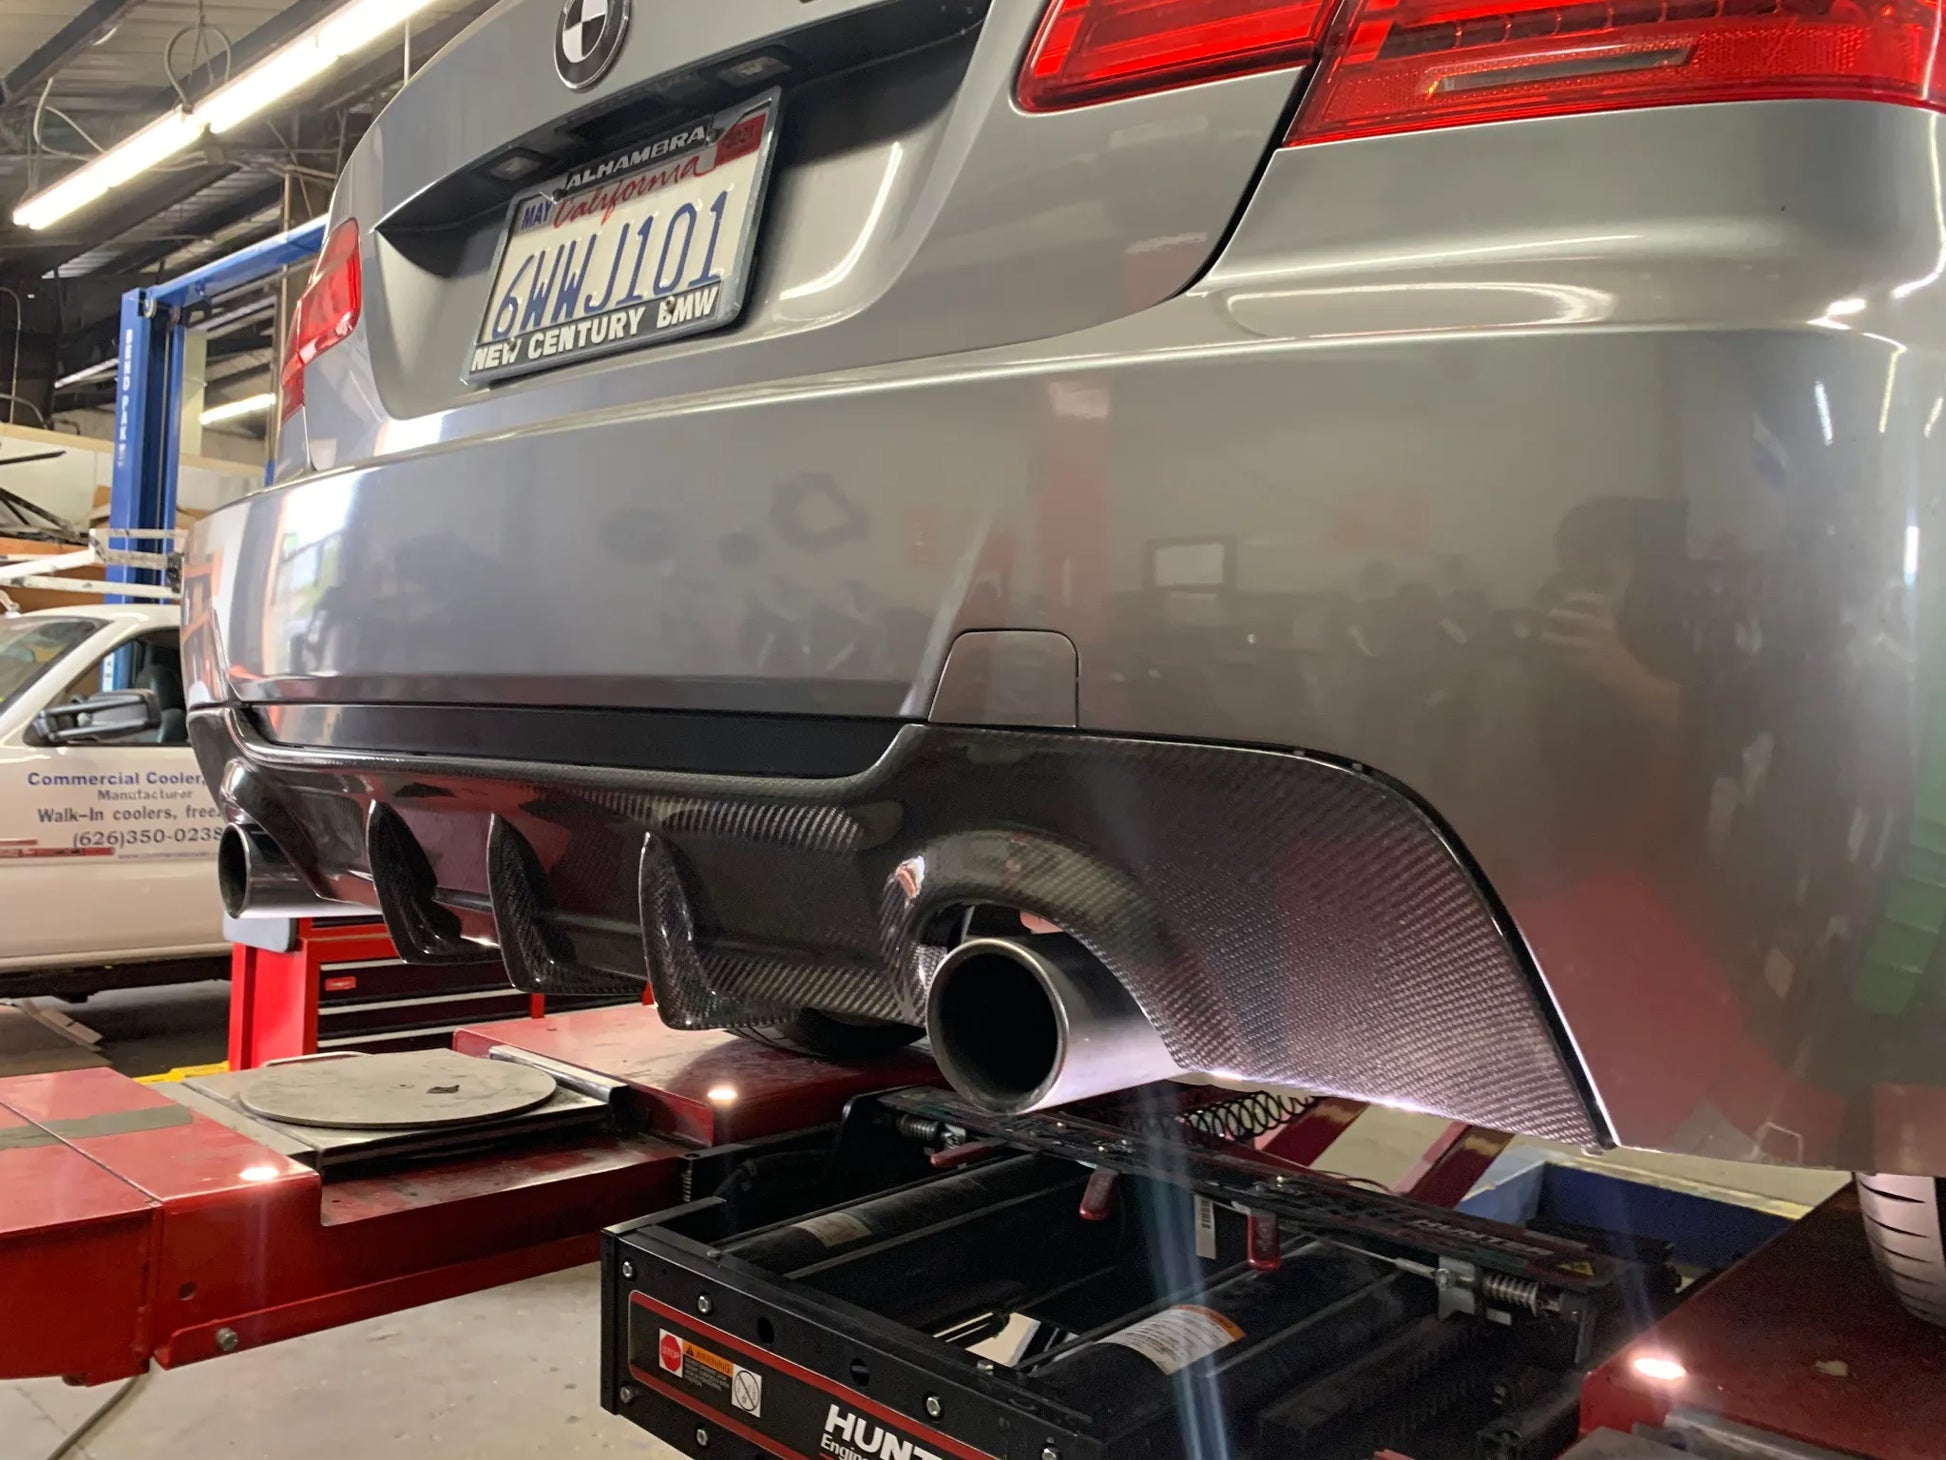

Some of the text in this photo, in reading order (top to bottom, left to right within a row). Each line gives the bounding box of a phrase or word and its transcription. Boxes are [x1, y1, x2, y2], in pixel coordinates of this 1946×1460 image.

[566, 125, 706, 190] ALHAMBRA
[553, 155, 716, 229] California
[521, 200, 553, 231] MAY
[491, 190, 729, 339] 6WWJ101
[471, 287, 719, 371] NEW CENTURY BMW
[27, 771, 140, 786] Commercial
[97, 788, 193, 801] Manufacturer
[37, 804, 221, 823] Walk-In coolers, free
[73, 826, 223, 849] (626)350-0238
[820, 1433, 869, 1460] Engin
